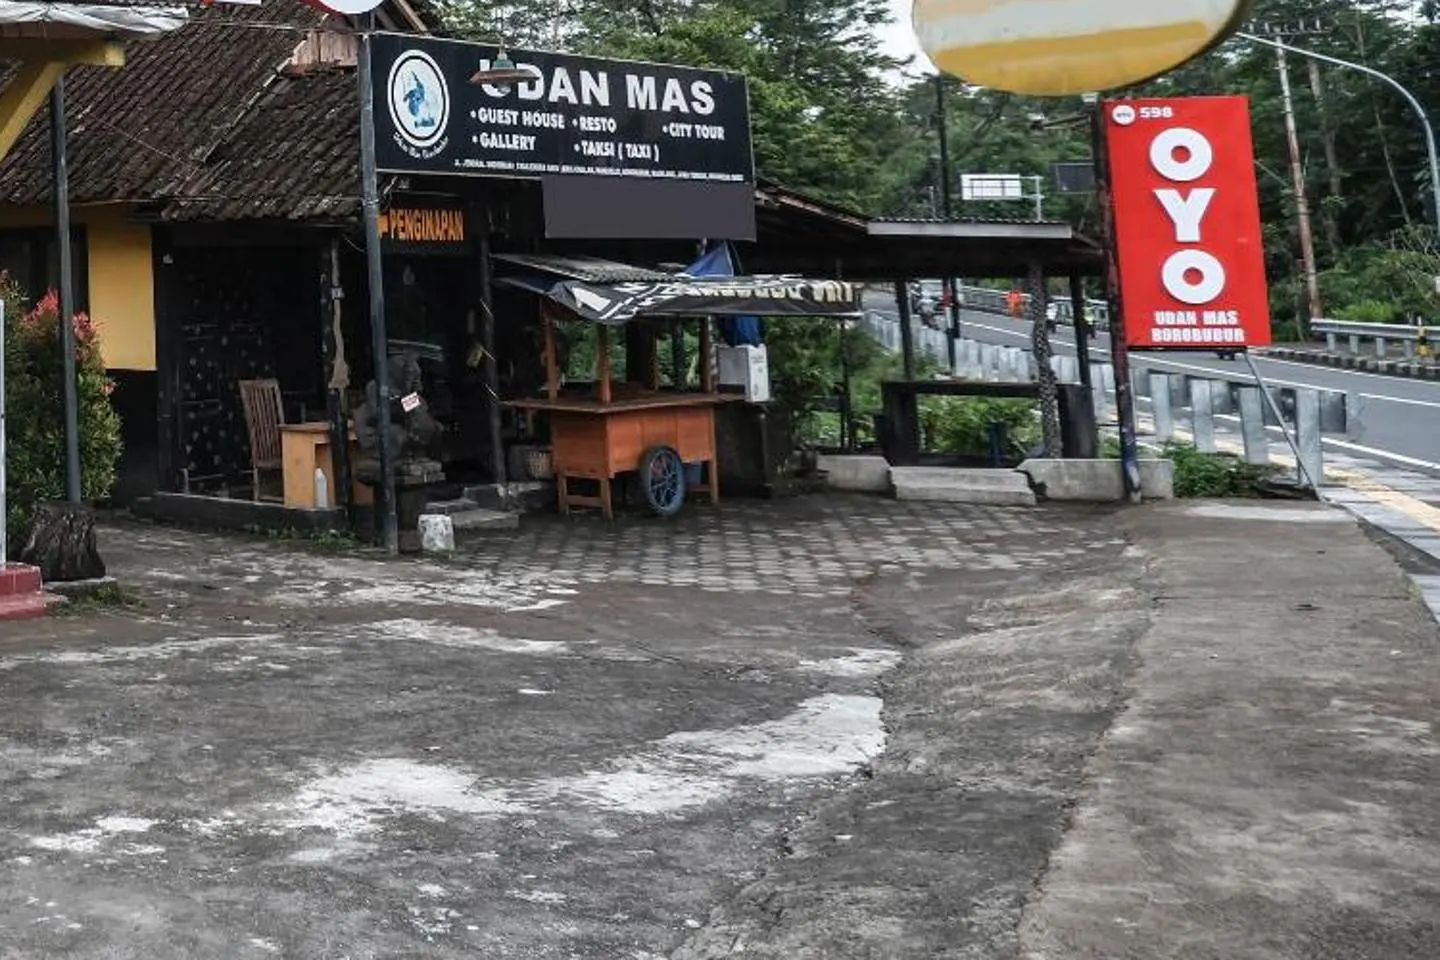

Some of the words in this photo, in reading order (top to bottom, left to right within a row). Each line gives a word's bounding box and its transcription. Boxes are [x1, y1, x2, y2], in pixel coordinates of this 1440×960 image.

[625, 73, 716, 115] MAS
[478, 109, 520, 127] GUEST
[522, 111, 565, 130] HOUSE
[579, 116, 617, 133] RESTO
[669, 123, 694, 139] CITY
[695, 125, 725, 141] TOUR
[481, 132, 537, 151] GALLERY
[582, 140, 615, 158] TAKSI
[389, 208, 465, 241] PENGINAPAN
[1149, 127, 1226, 305] OYO
[1154, 310, 1198, 325] UDAN
[1202, 310, 1239, 325] MAS
[1150, 327, 1246, 343] BOROBUDUR
